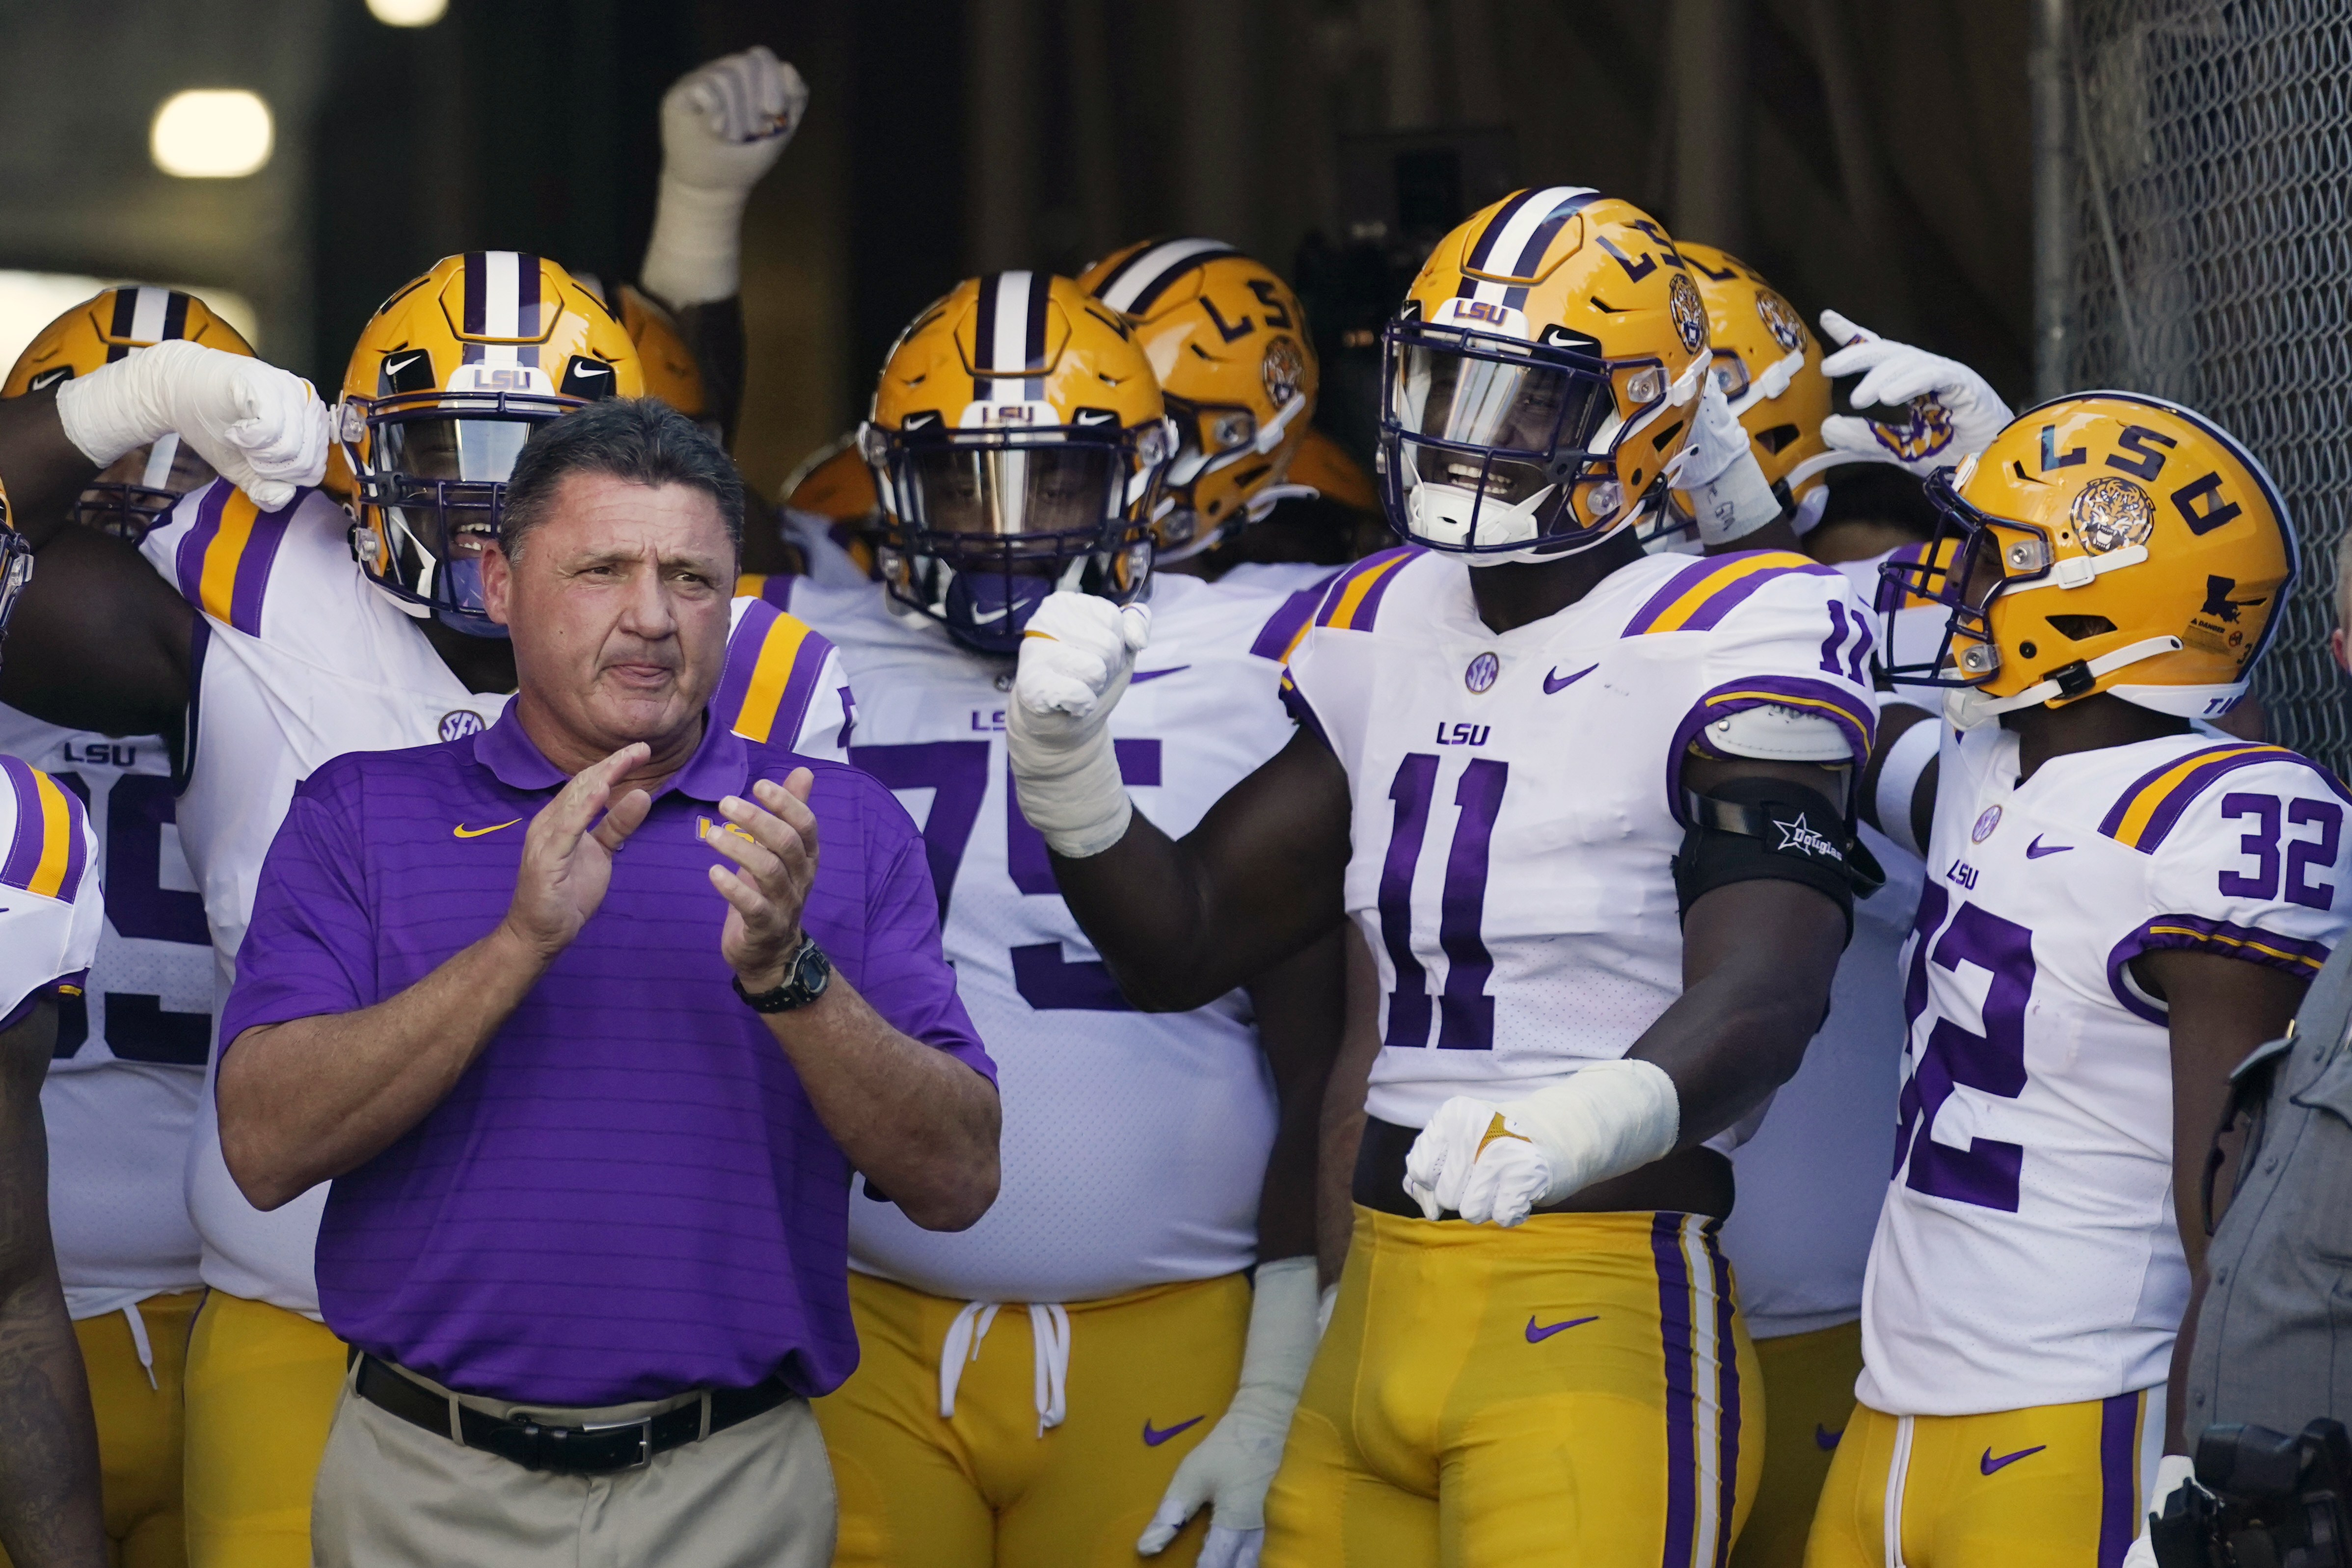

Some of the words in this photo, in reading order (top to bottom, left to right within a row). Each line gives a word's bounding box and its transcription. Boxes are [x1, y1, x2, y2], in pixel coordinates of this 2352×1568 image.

[1454, 300, 1509, 326] LSU
[474, 369, 531, 391] LSU
[2041, 424, 2242, 536] LSU
[1819, 599, 1873, 687] 11
[1467, 654, 1497, 692] SEC
[971, 710, 1007, 731] LS
[1436, 722, 1490, 746] LSU
[64, 742, 136, 767] LSU
[2218, 793, 2344, 911] 32
[1946, 859, 1979, 890] LSU
[1378, 752, 1509, 1050] 11
